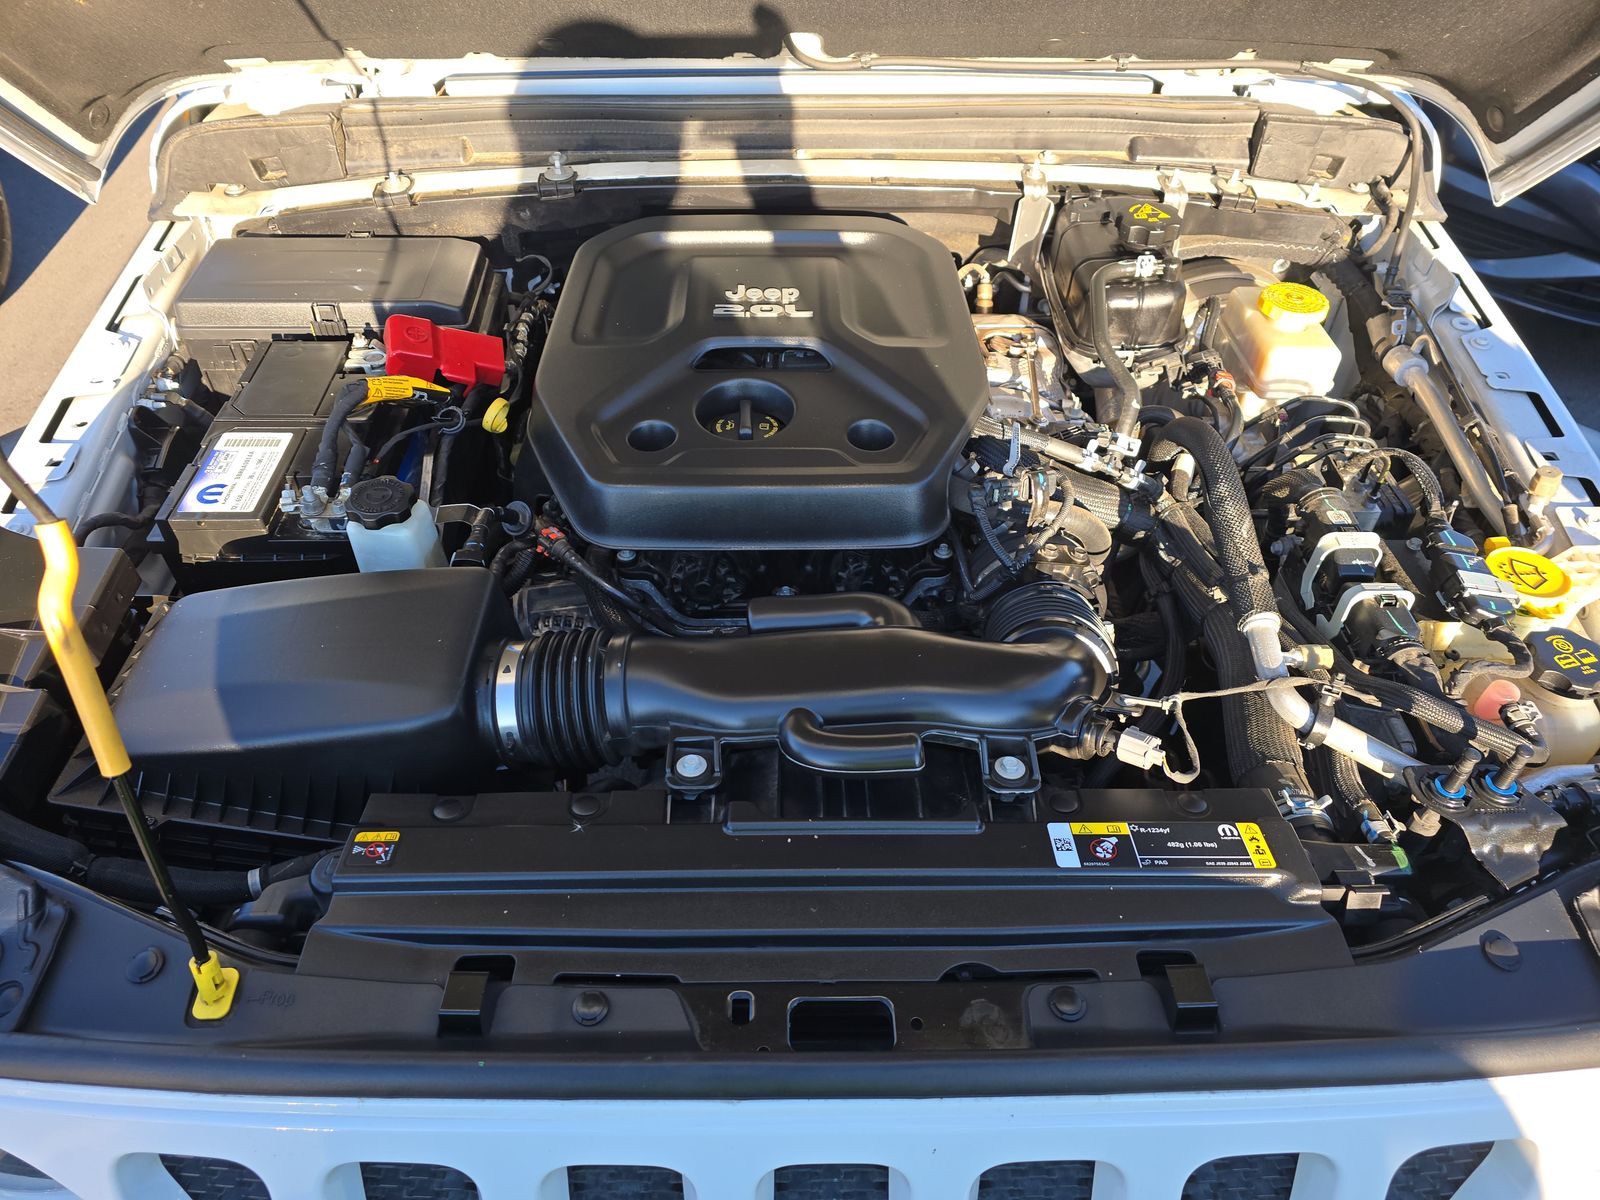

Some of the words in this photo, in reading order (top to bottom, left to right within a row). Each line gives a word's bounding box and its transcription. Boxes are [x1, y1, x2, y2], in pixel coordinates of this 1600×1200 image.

[724, 284, 800, 304] Jeep
[713, 304, 814, 318] 2.0L
[1167, 841, 1184, 849] 482g
